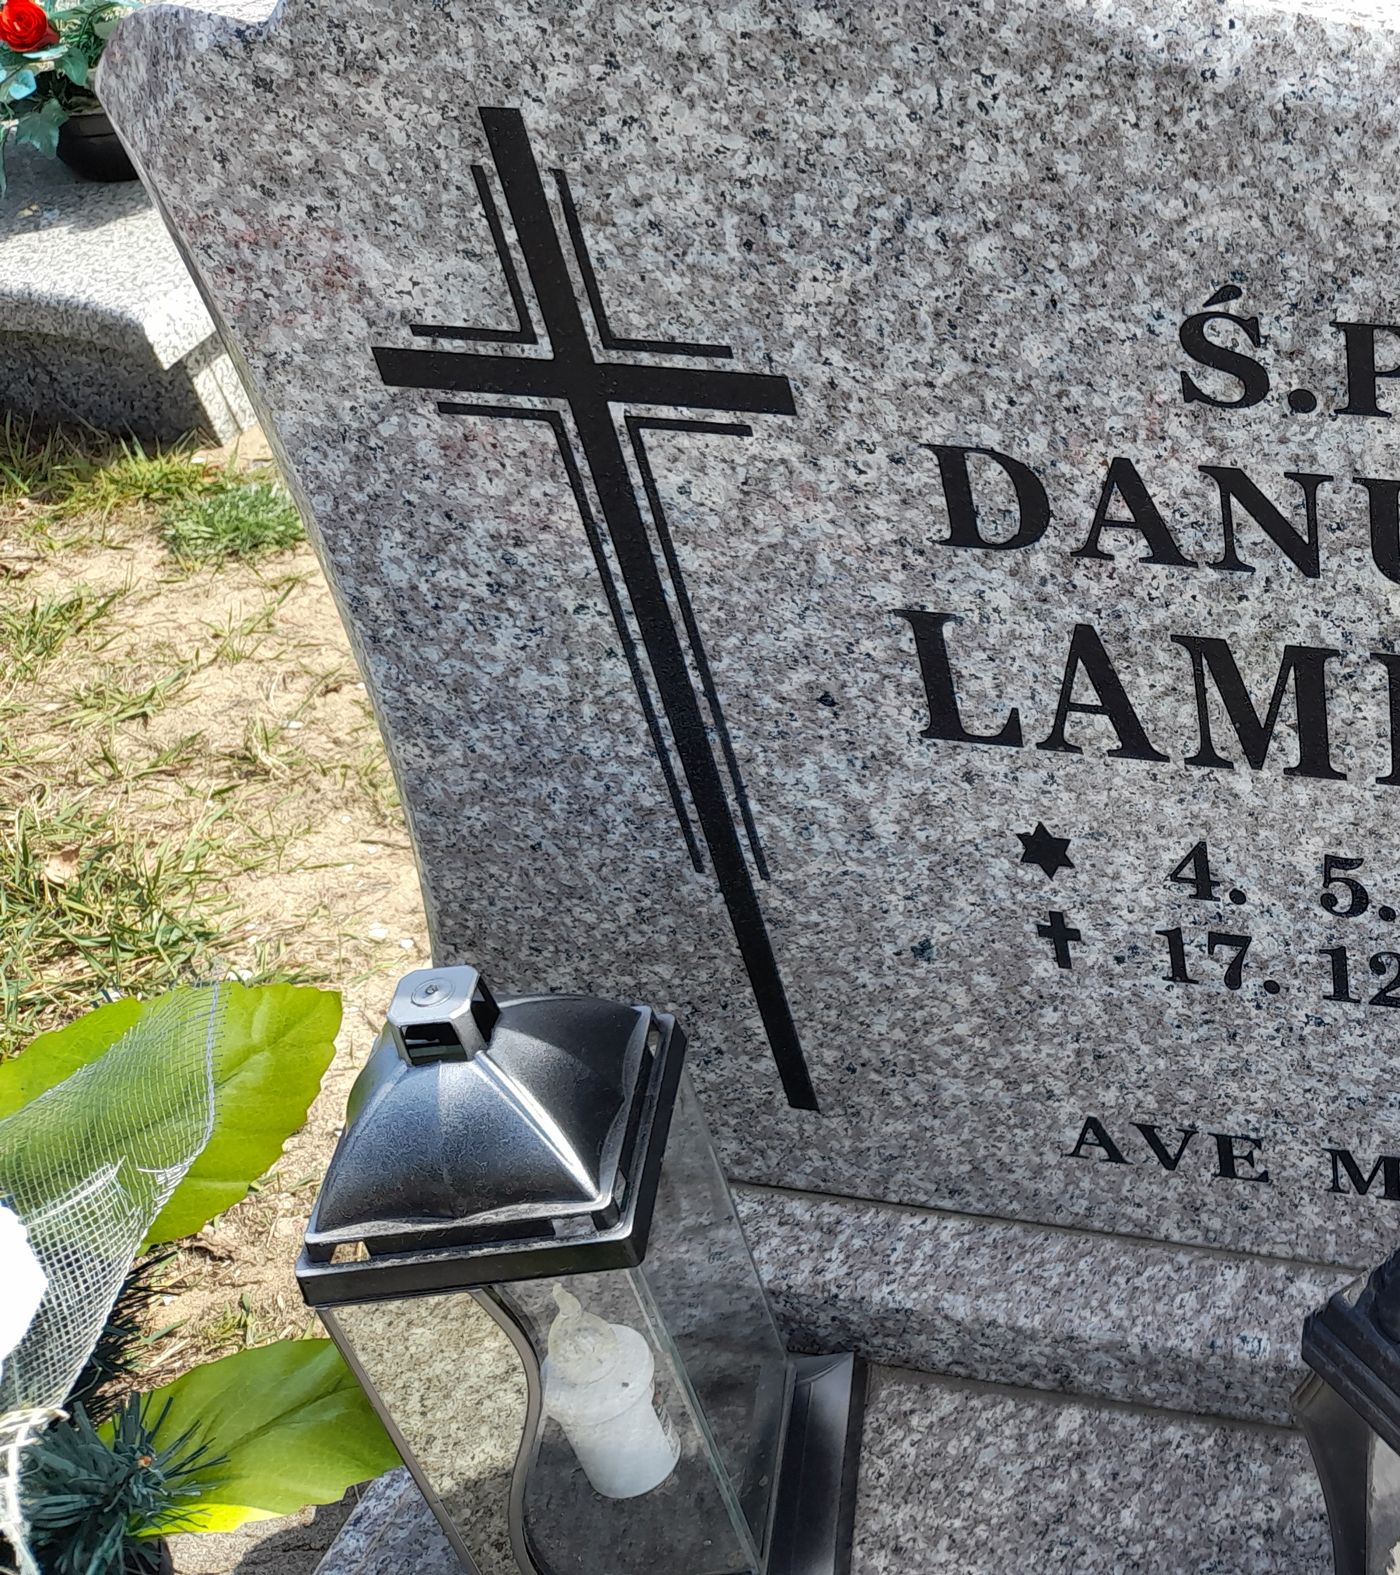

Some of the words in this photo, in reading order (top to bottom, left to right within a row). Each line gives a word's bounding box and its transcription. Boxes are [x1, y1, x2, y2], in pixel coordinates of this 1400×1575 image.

[1169, 841, 1248, 905] 4.
[1319, 854, 1397, 922] 5.
[1155, 927, 1281, 994] 17.
[1062, 1116, 1271, 1183] AVE
